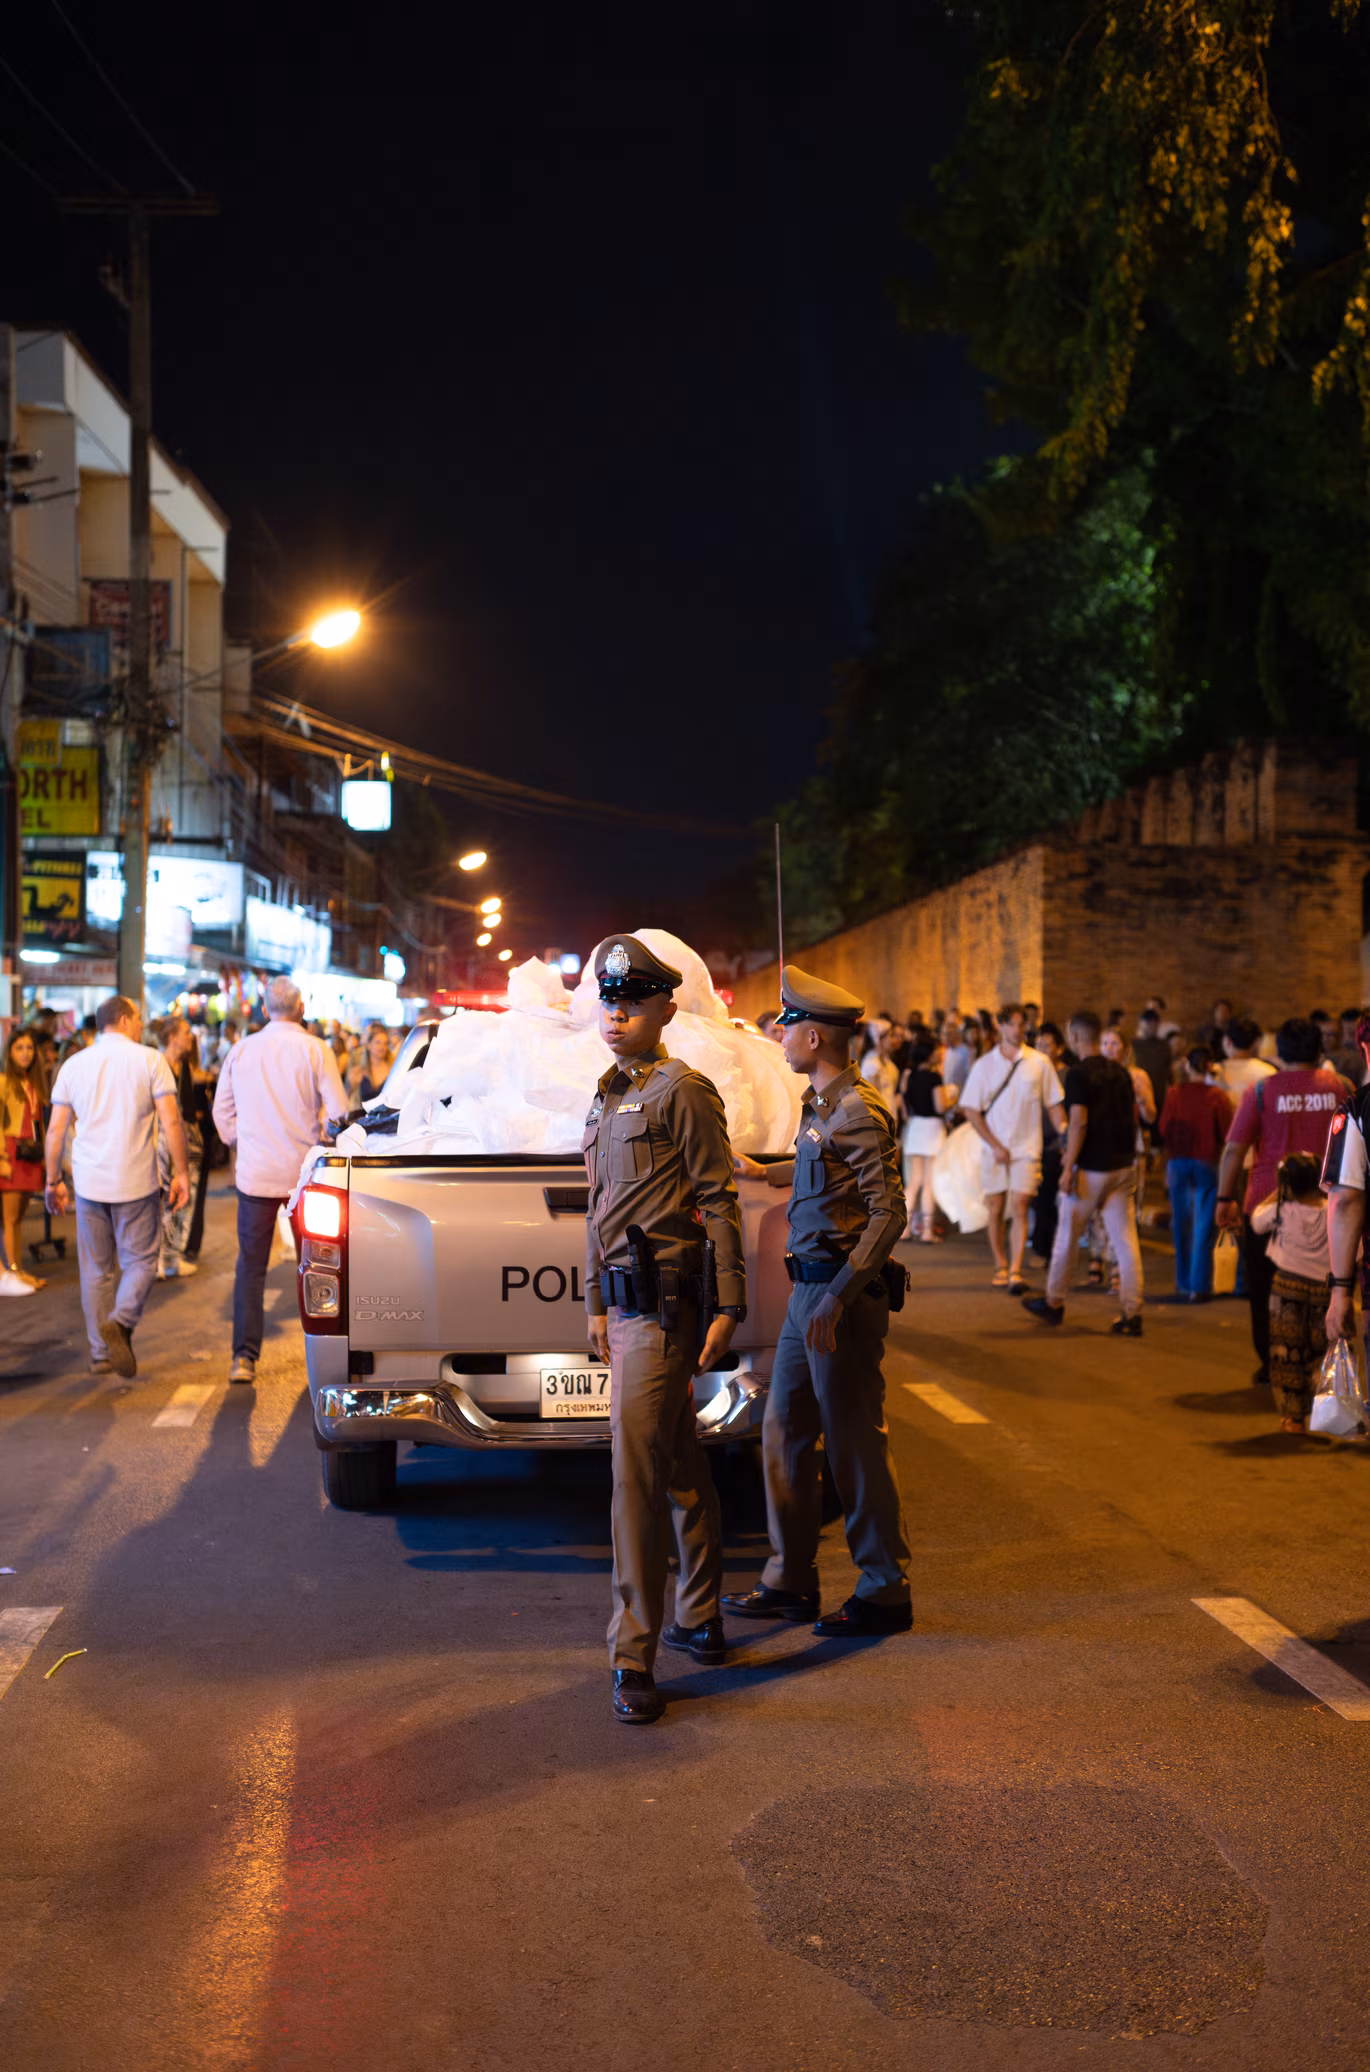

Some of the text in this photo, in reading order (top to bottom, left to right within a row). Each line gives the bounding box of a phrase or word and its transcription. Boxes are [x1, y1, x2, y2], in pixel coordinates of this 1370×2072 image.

[20, 768, 88, 800] ORTH
[21, 807, 50, 829] EL
[1278, 1093, 1337, 1113] ACC 2018
[501, 1265, 585, 1302] POL
[356, 1296, 400, 1305] ISUZU
[597, 1373, 609, 1395] 7
